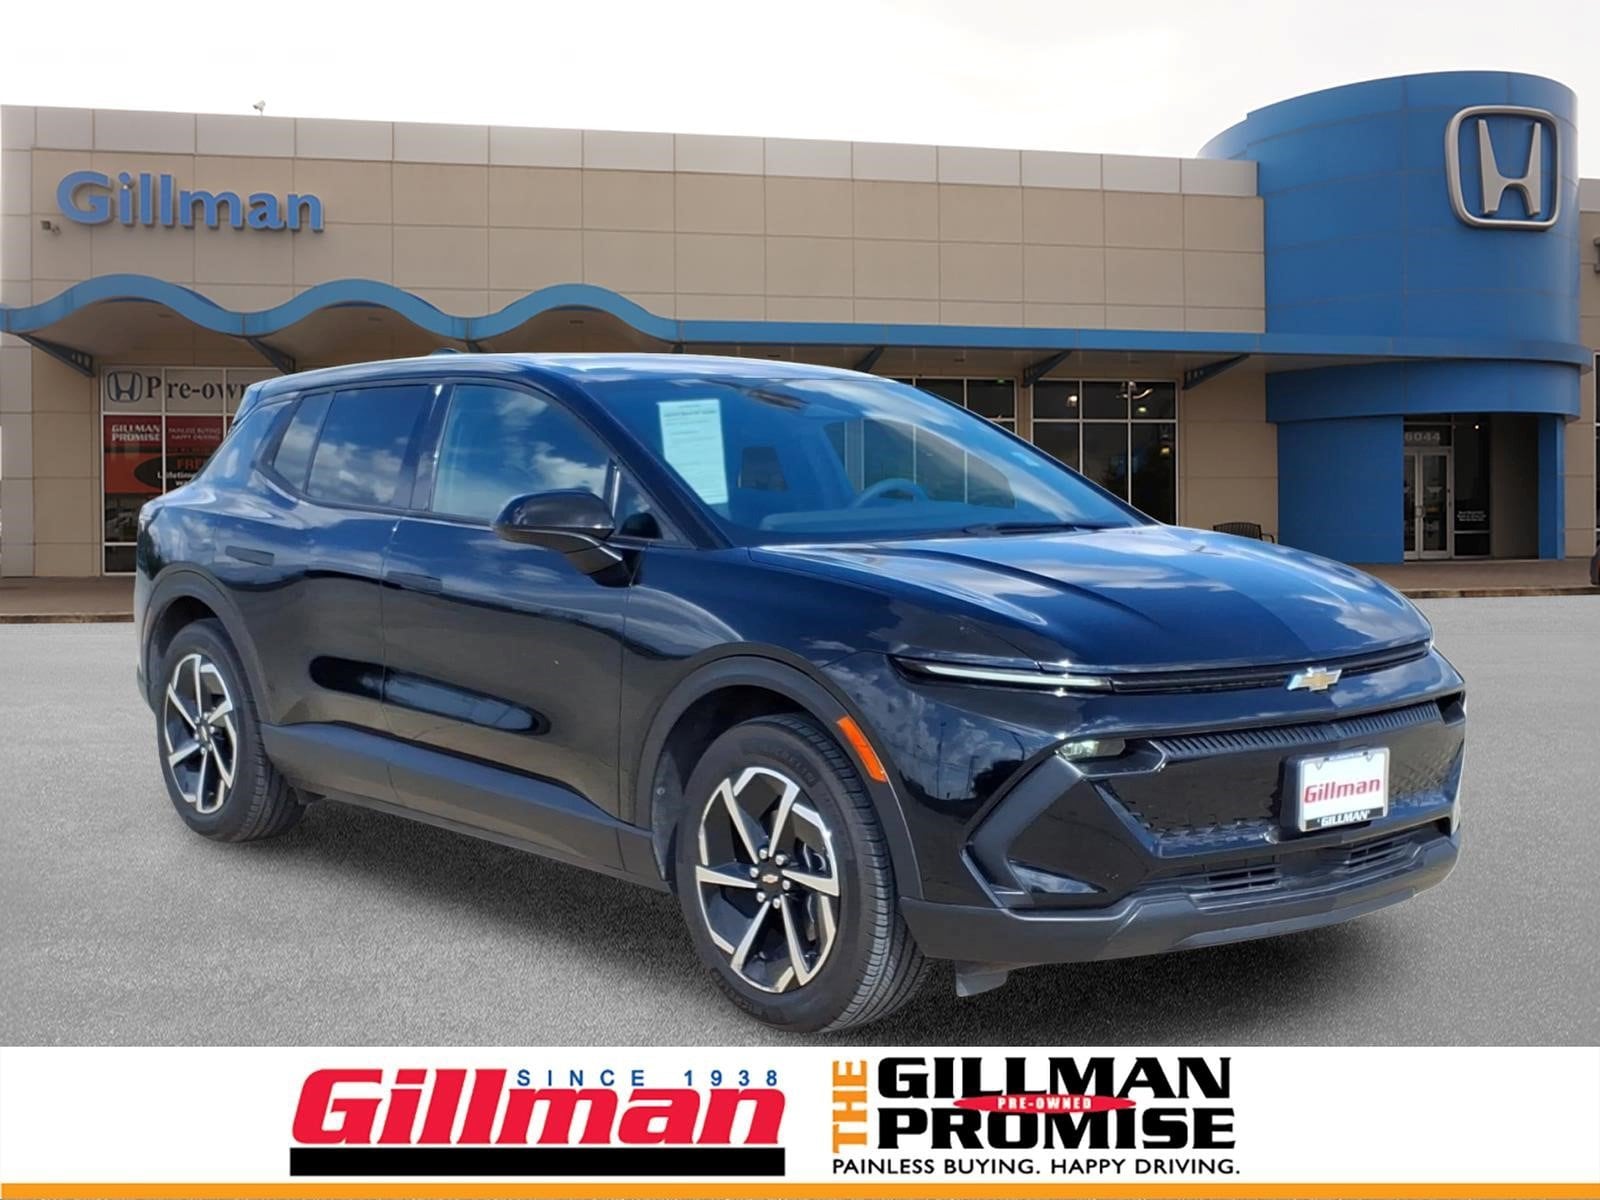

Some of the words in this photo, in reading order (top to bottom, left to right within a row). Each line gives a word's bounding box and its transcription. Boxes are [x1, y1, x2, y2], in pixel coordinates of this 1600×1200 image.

[56, 170, 325, 232] Gillman
[112, 424, 160, 432] GILLMAN
[112, 433, 160, 441] PROMISE
[1304, 779, 1380, 803] Gillman
[1320, 811, 1368, 827] GILLMAN
